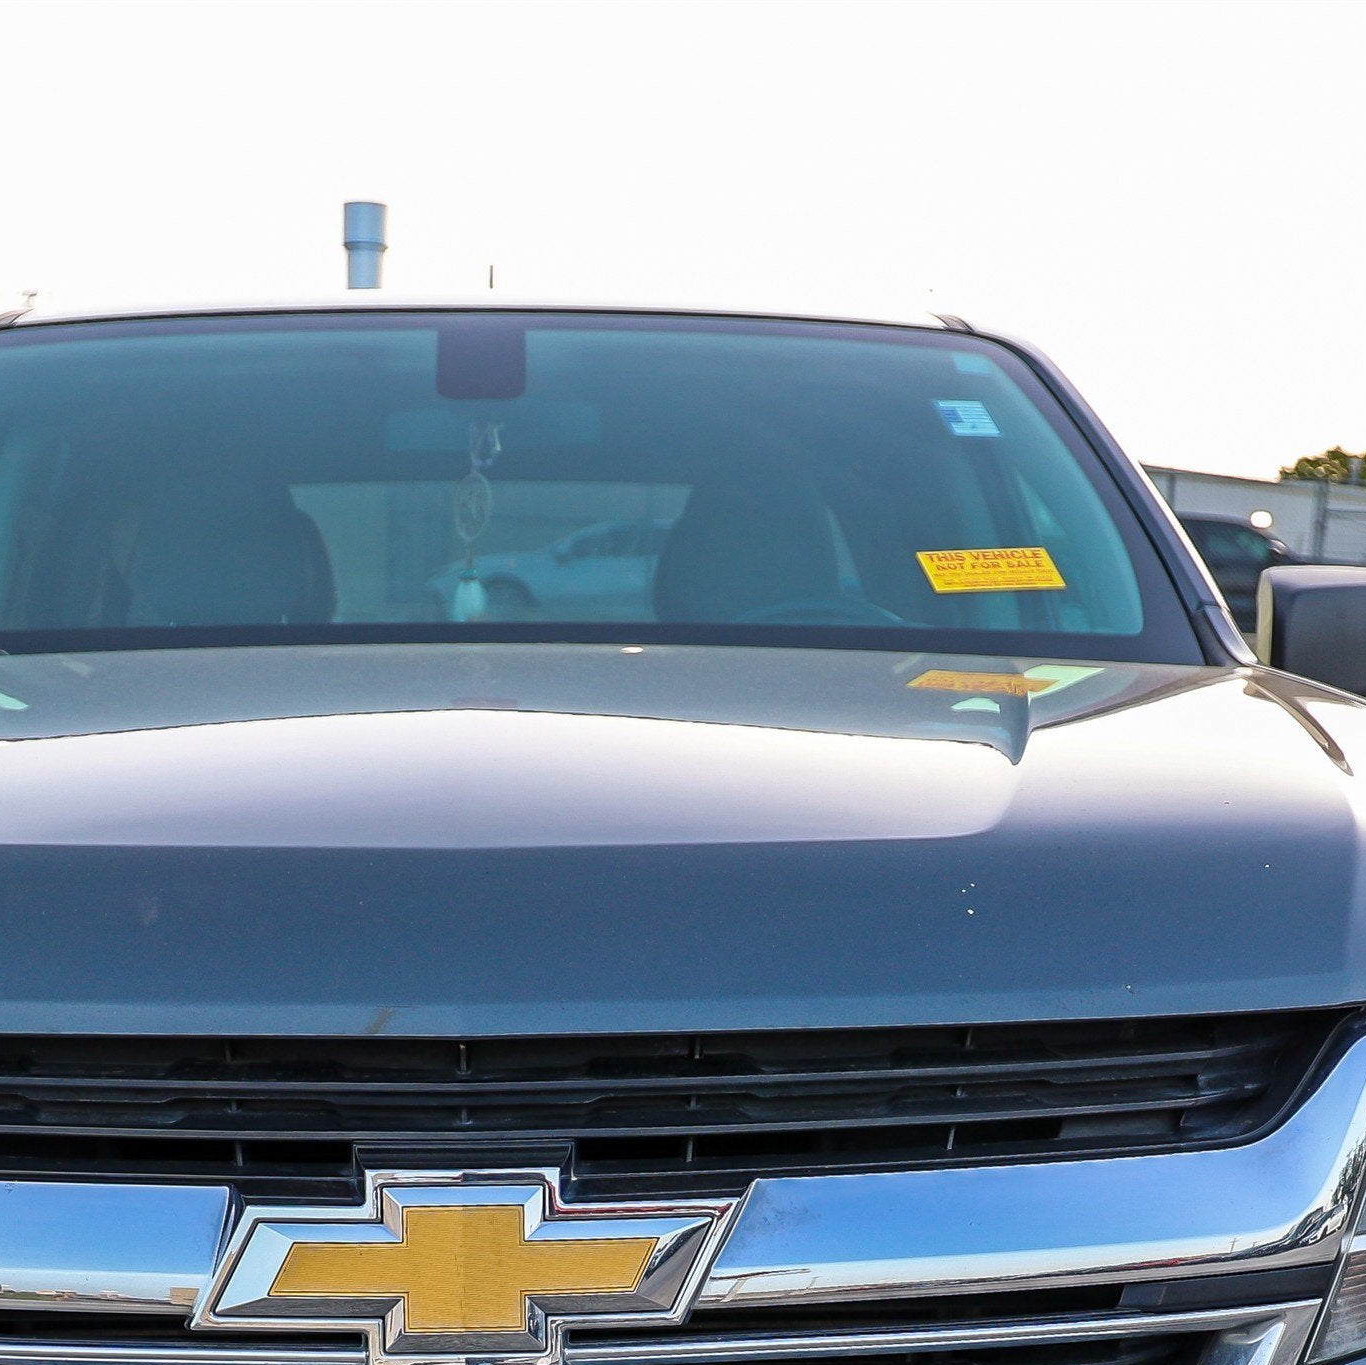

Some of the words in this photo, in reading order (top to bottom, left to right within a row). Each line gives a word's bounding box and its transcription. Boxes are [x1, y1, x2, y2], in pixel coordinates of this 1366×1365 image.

[925, 551, 965, 563] THIS
[968, 549, 1044, 561] VEHICLE
[936, 562, 965, 571] NOT
[970, 561, 1002, 570] FOR
[1008, 560, 1044, 568] SALE
